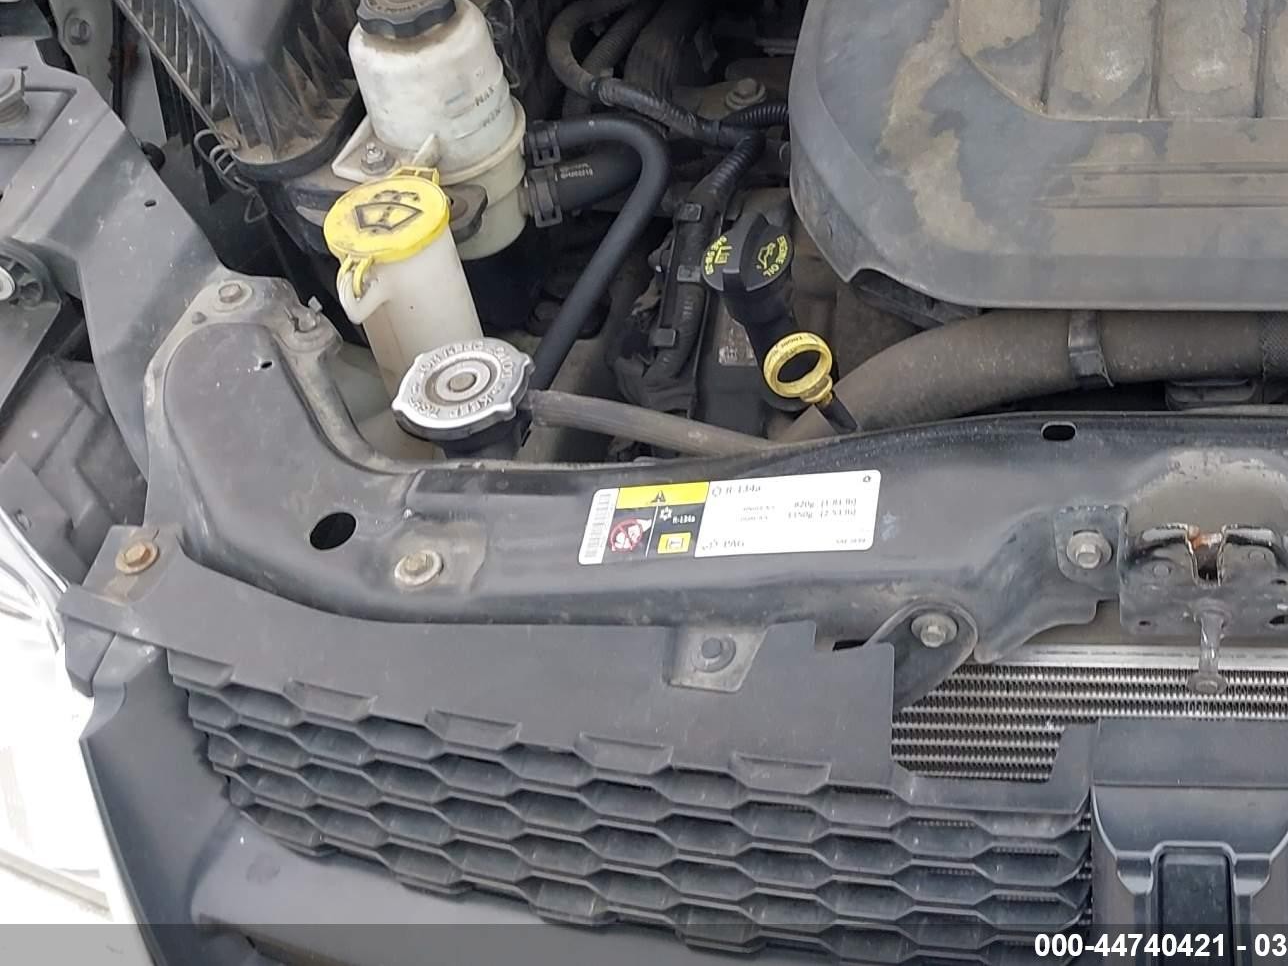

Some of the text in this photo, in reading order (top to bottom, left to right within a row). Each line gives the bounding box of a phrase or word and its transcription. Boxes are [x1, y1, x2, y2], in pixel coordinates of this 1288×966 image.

[474, 85, 496, 107] MAX
[763, 235, 789, 277] ENGINE OIL
